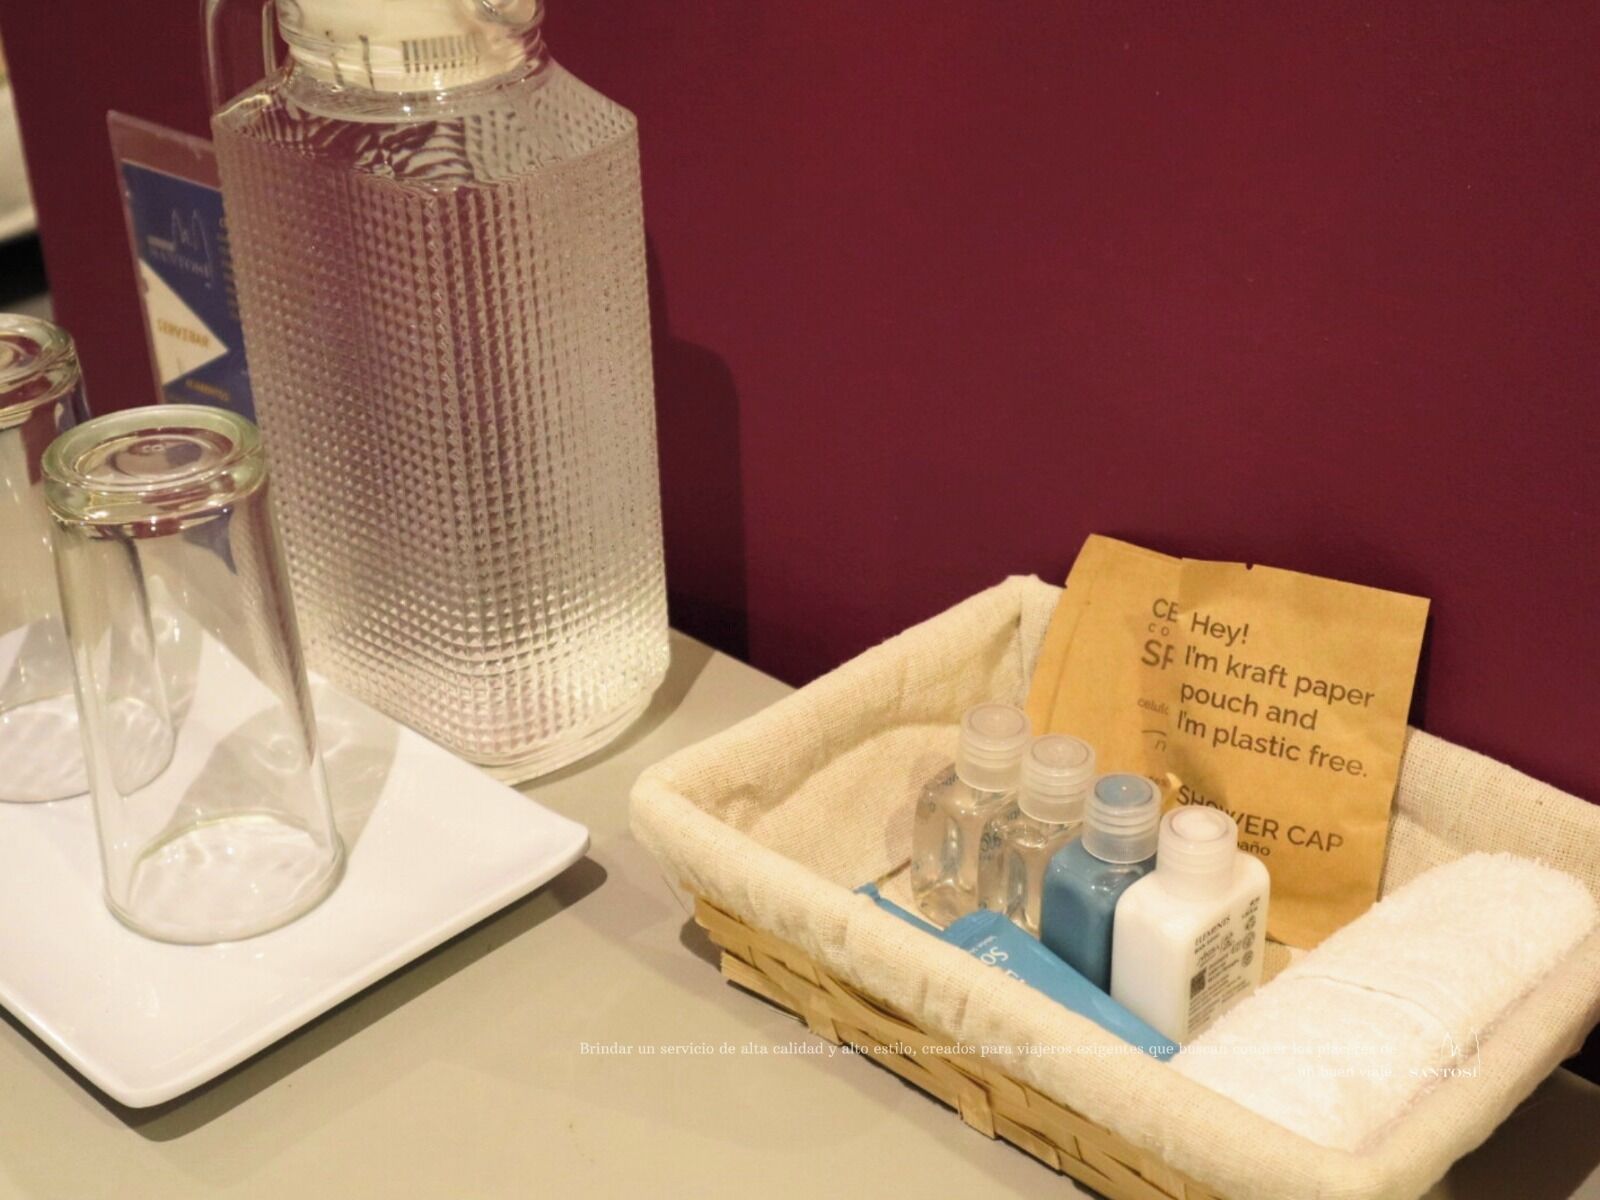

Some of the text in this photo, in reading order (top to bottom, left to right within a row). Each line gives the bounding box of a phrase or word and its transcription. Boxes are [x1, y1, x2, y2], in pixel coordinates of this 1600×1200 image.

[1190, 612, 1249, 647] Hey!
[1185, 645, 1375, 707] I'm kraft paper
[1180, 683, 1318, 731] pouch and
[1177, 710, 1367, 778] I'm plastic free.
[1237, 840, 1271, 856] año
[1287, 825, 1344, 852] CAP
